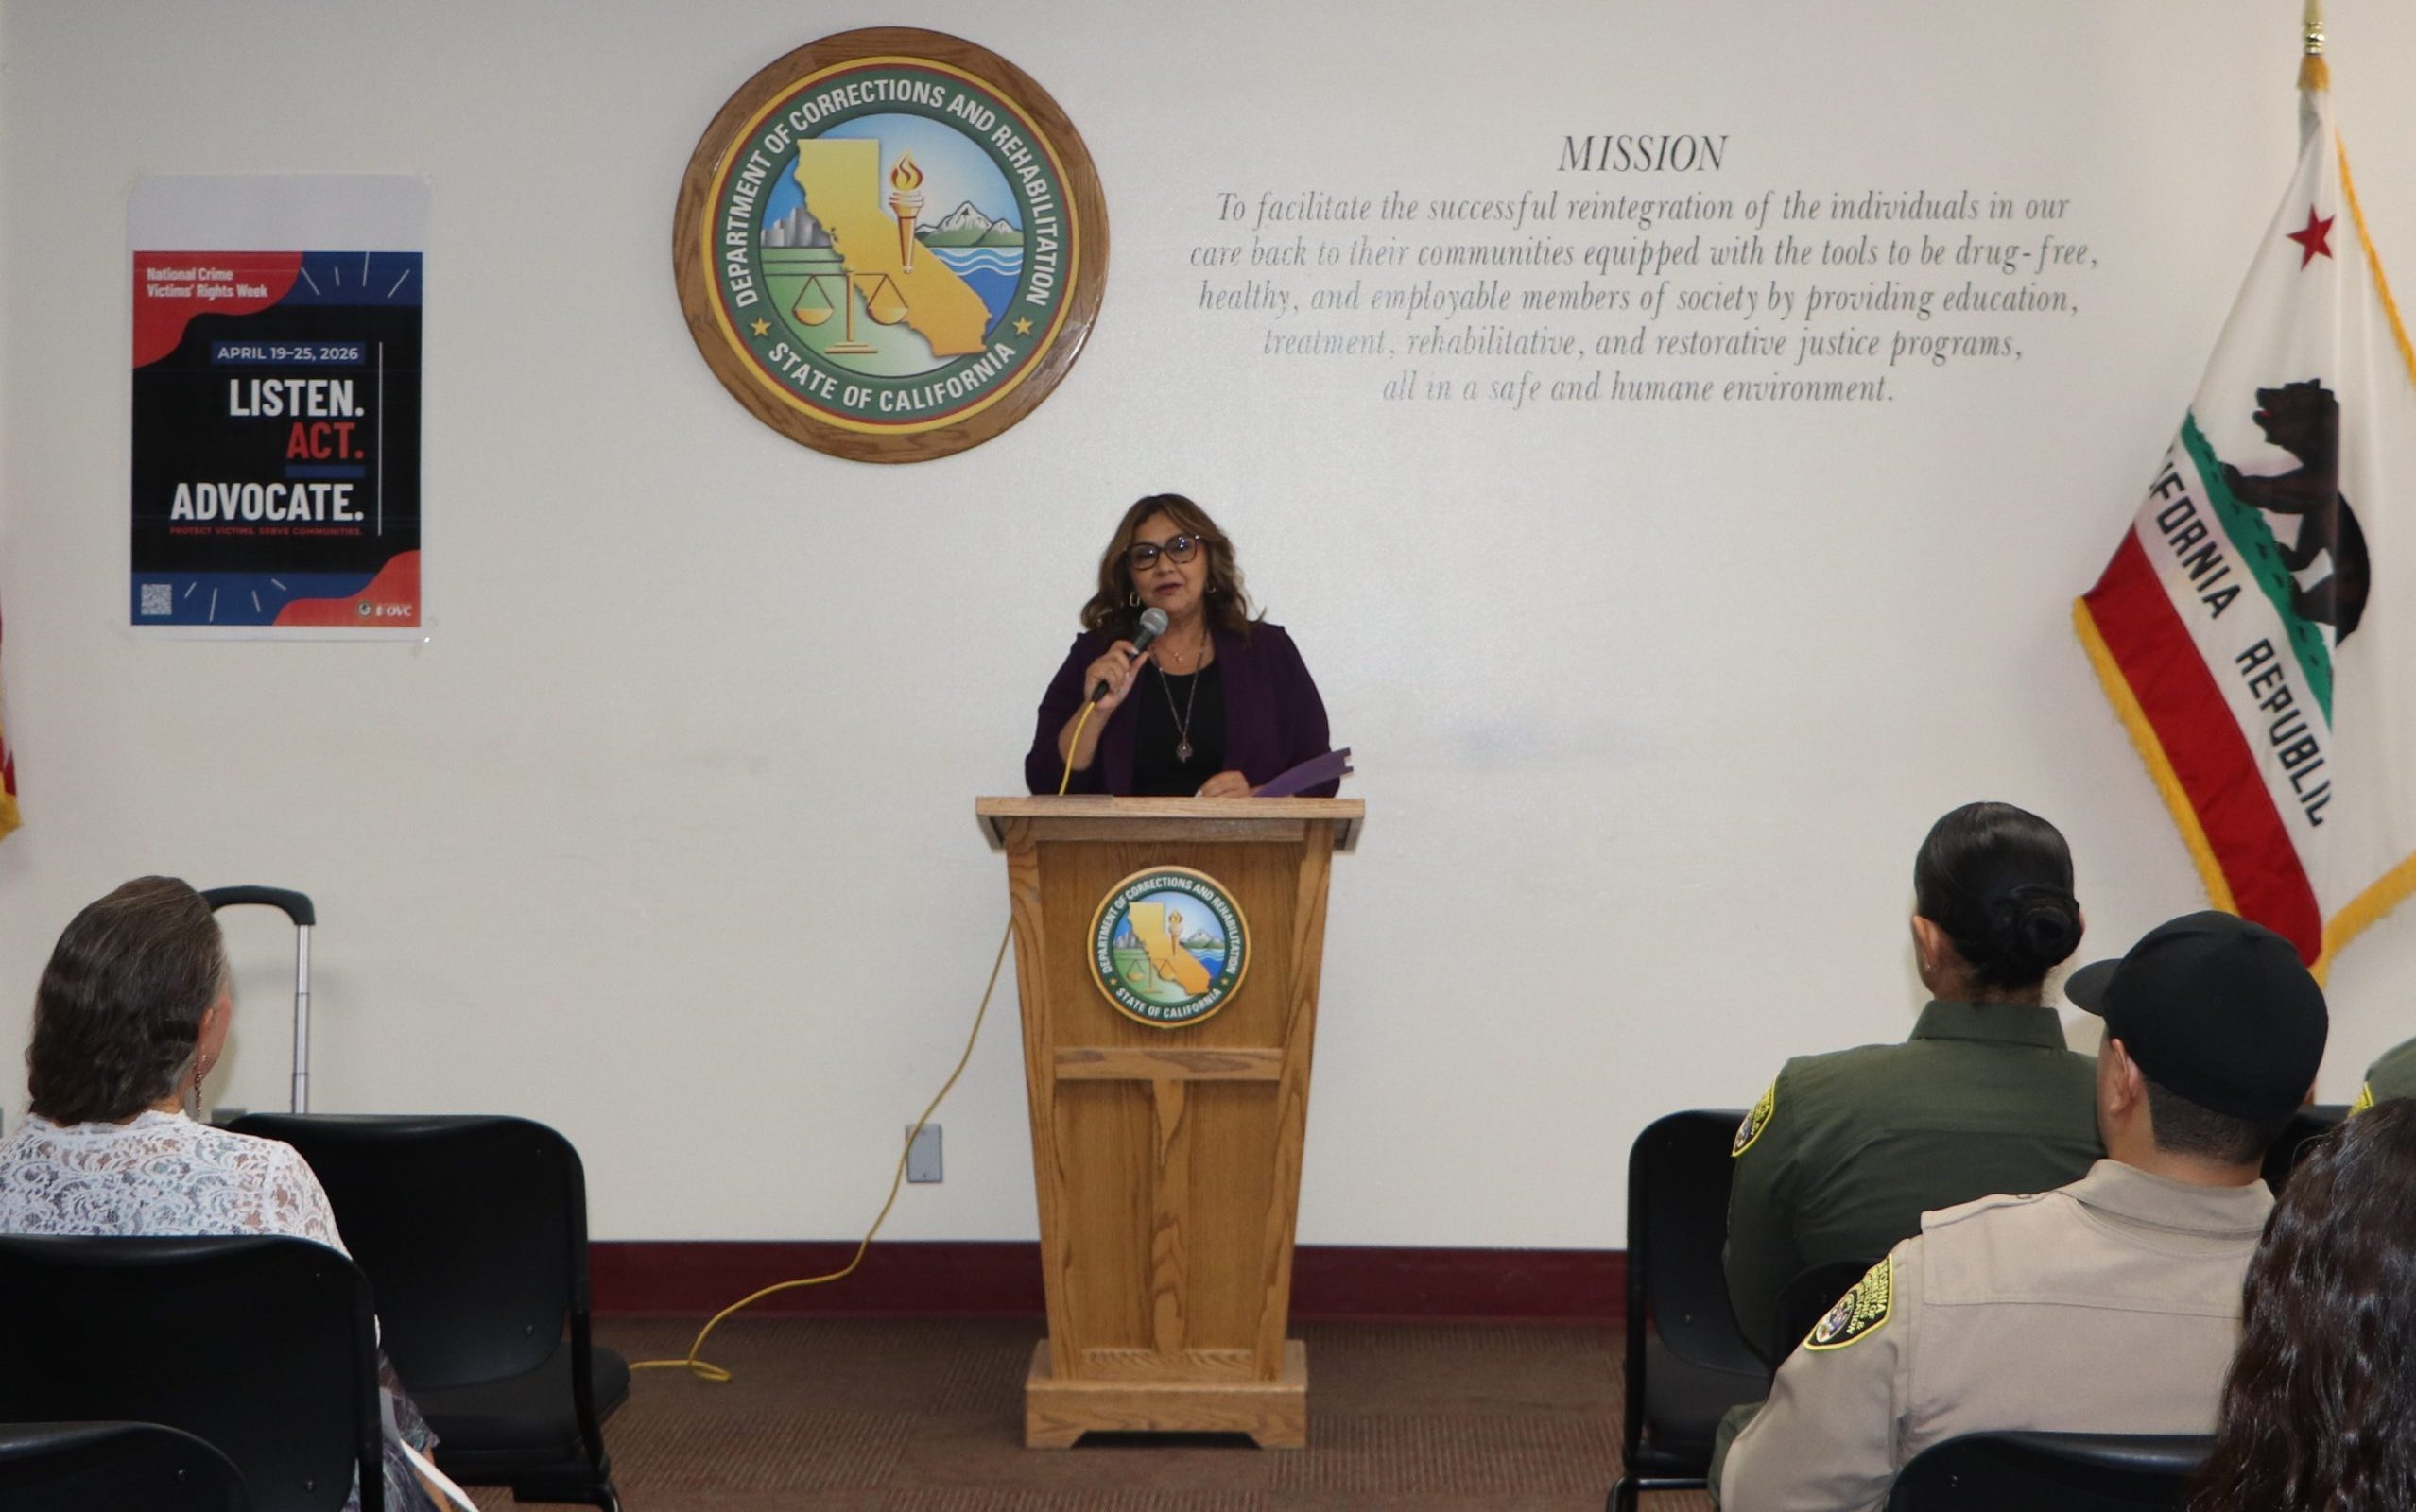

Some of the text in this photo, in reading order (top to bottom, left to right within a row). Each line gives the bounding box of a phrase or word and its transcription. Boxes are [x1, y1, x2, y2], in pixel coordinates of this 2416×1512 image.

[1558, 134, 1729, 172] MISSION
[727, 79, 1059, 308] DEPARTMENT OF CORRECTIONS AND REHABILITATION
[1217, 190, 2069, 230] To facilitate the successful reintegration of the individuals in our
[147, 267, 233, 281] National Crime
[1190, 235, 2097, 276] care back to their communities equipped with the tools to be drug-free,
[196, 284, 234, 301] Rights
[236, 284, 268, 298] Week
[1199, 280, 2079, 321] healthy, and employable members of society by providing education,
[217, 346, 267, 360] APRIL
[320, 346, 359, 360] 2026
[1264, 325, 2022, 367] treatment, rehabilitative, and restorative justice programs,
[769, 341, 1016, 412] STATE OF CALIFORNIA
[1384, 369, 1893, 409] all in a safe and humane environment.
[229, 379, 365, 418] LISTEN.
[286, 422, 365, 460] ACT.
[170, 483, 365, 521] ADVOCATE.
[170, 527, 211, 536] PROTECT
[259, 527, 288, 536] SERVE
[1097, 876, 1241, 974] DEPARTMENT OF CORRECTIONS AND REHABILITATION
[1115, 987, 1222, 1018] STATE OF CALIFORNIA
